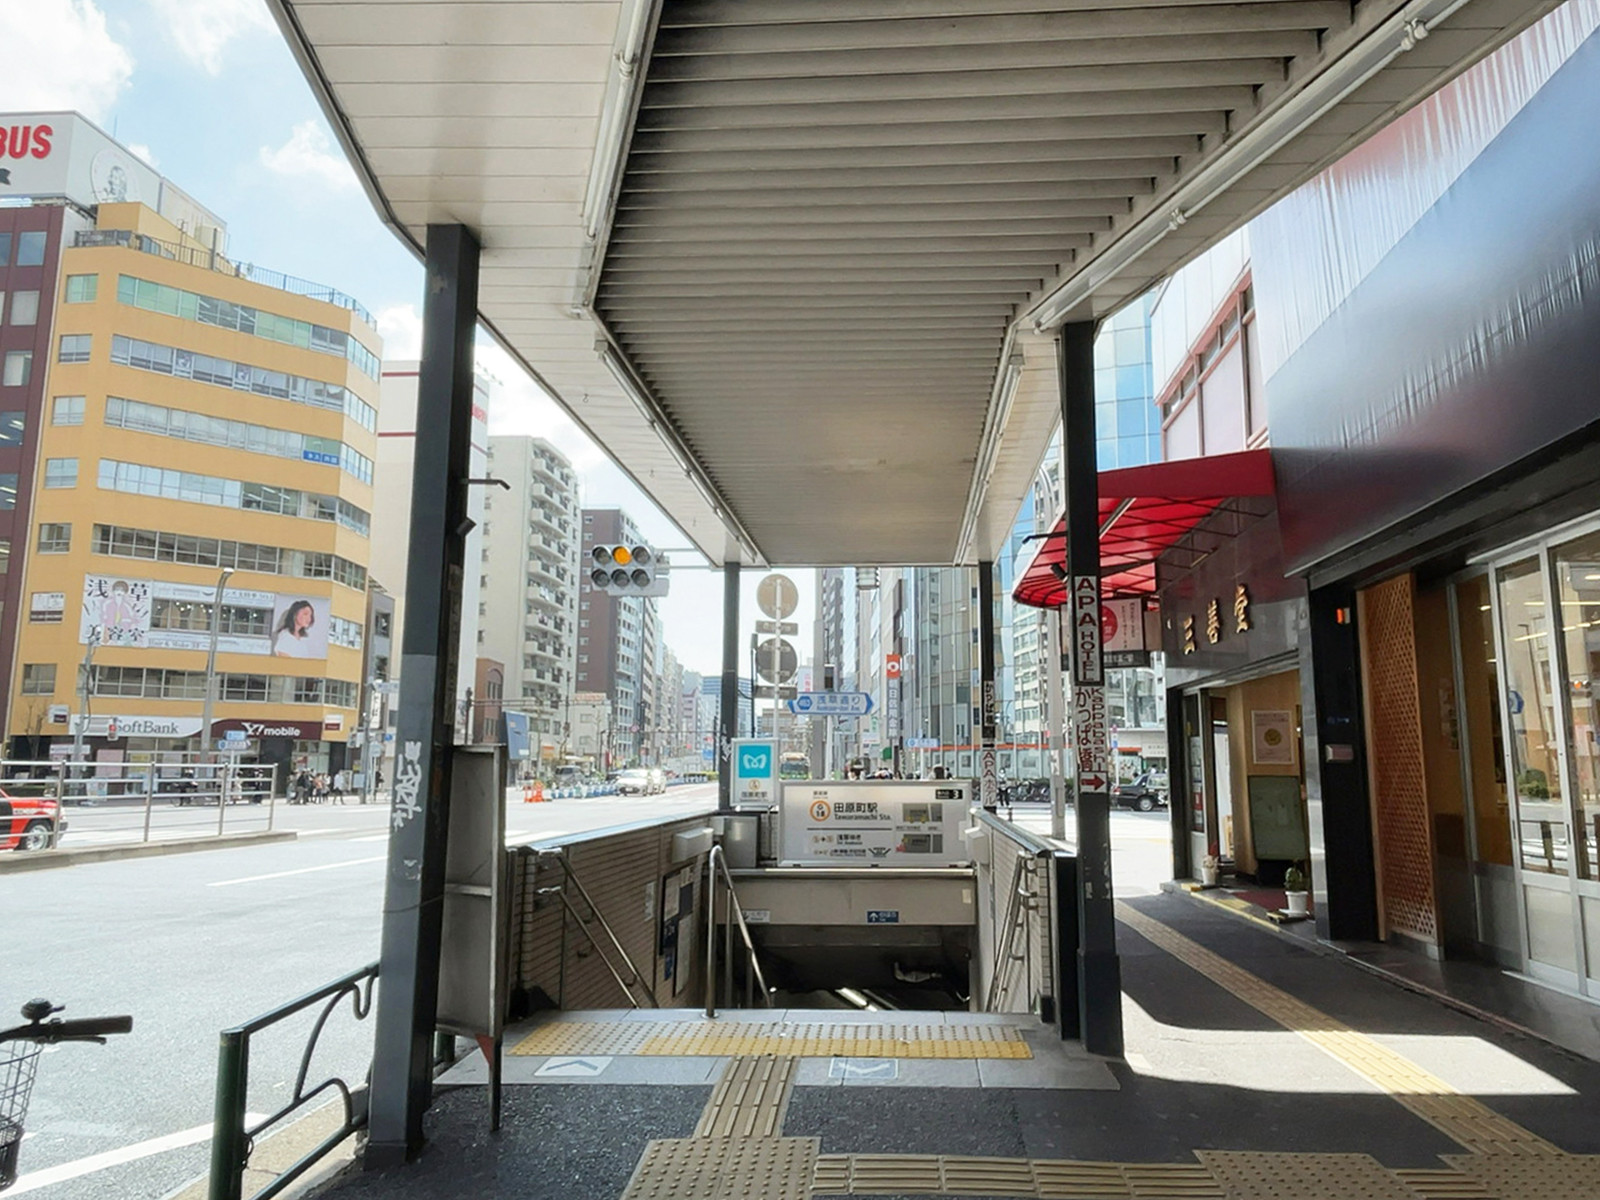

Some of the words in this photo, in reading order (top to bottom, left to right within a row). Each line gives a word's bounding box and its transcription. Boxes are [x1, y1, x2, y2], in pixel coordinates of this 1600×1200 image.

[1077, 577, 1096, 627] APA
[1081, 631, 1095, 681] HOTEL
[1091, 687, 1106, 772] Kappabashi
[834, 802, 878, 813] 田原町駅
[952, 789, 960, 800] 3
